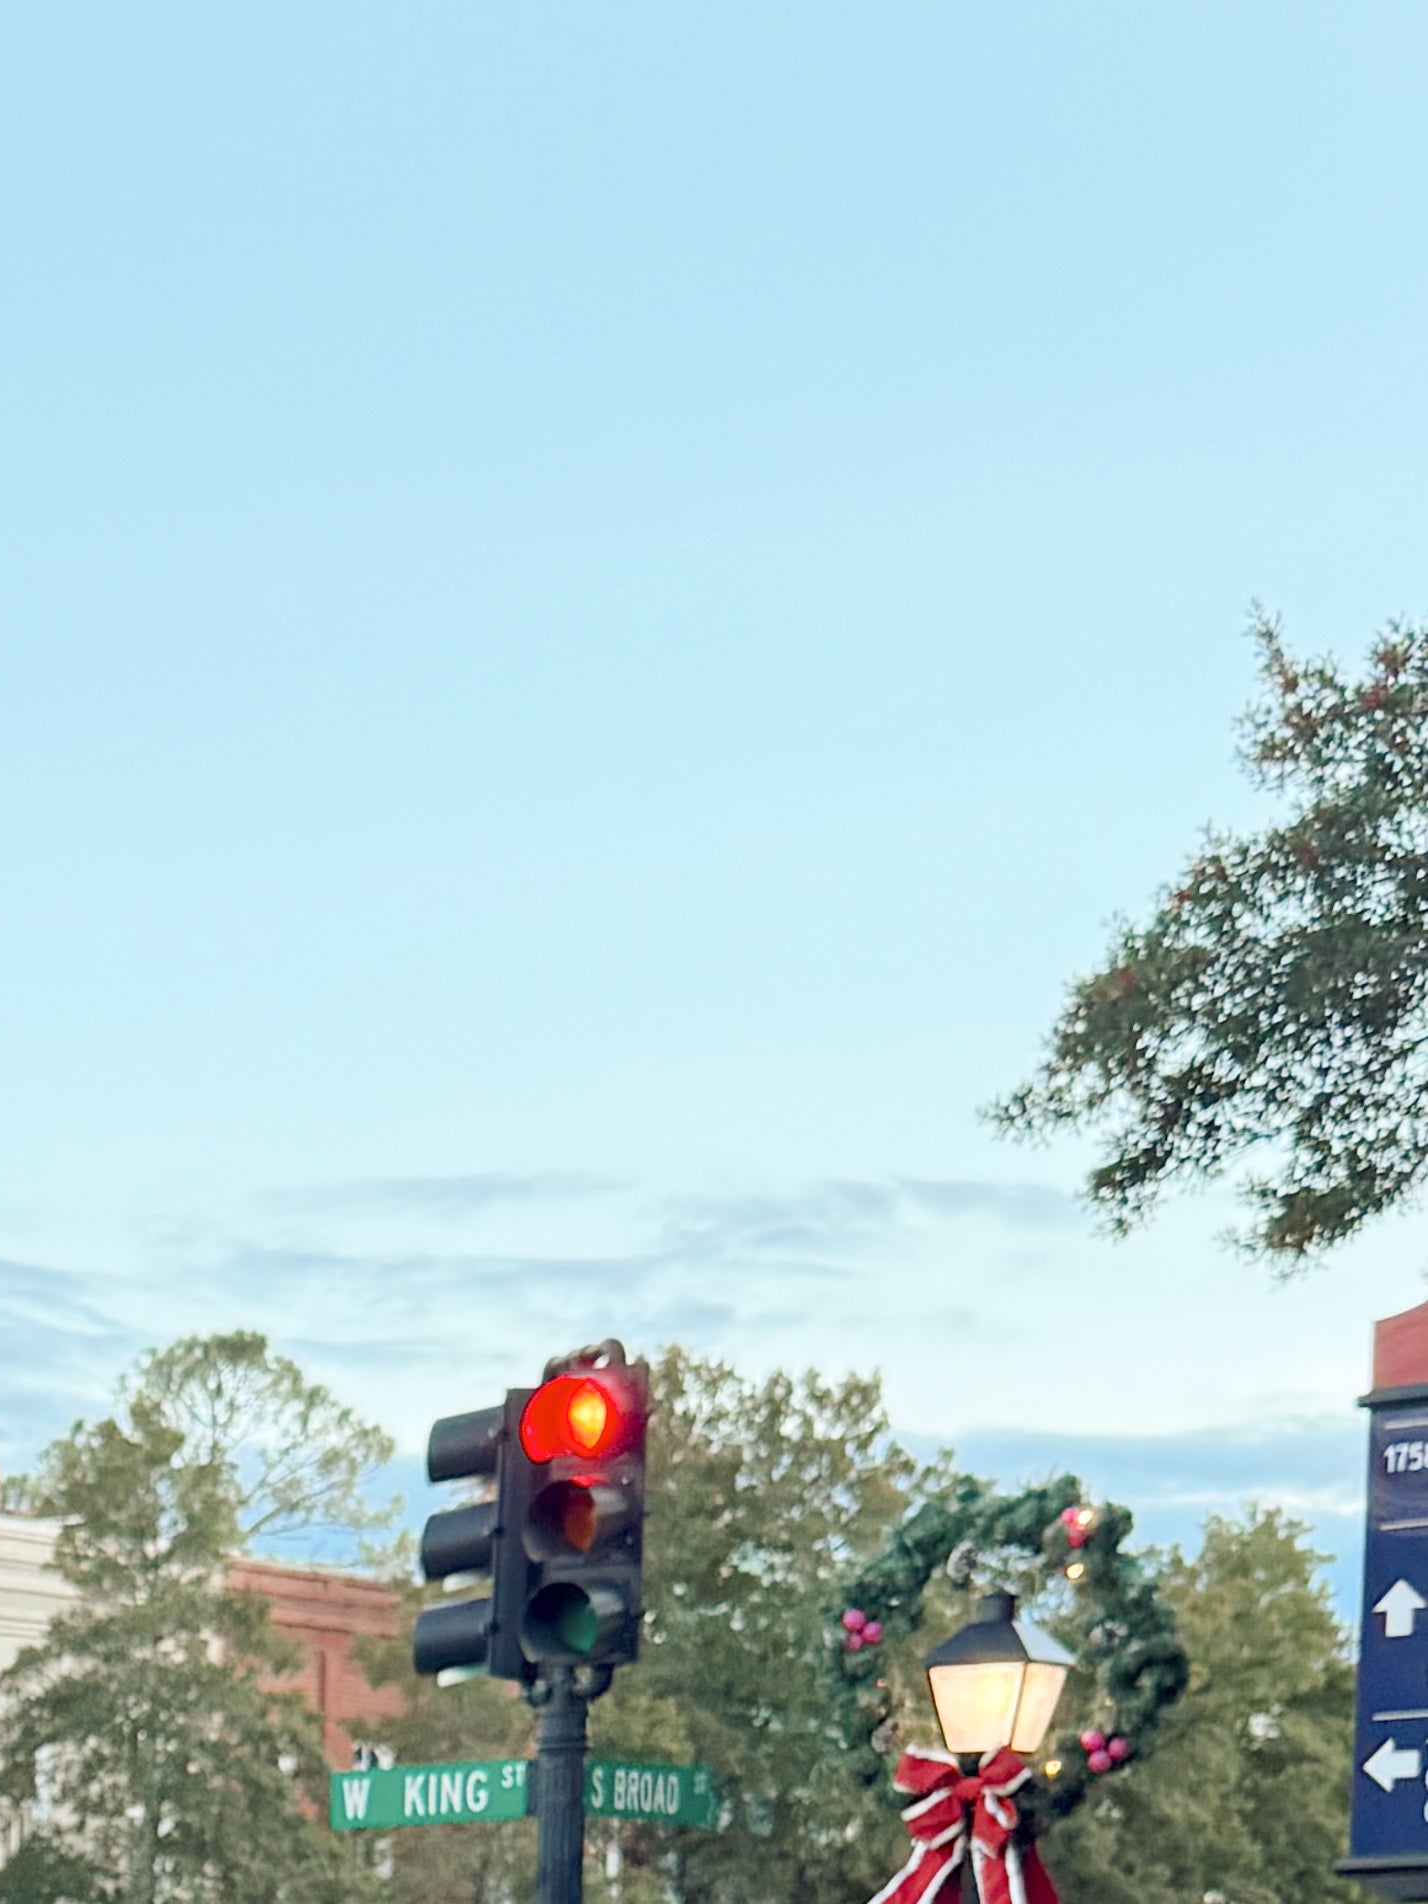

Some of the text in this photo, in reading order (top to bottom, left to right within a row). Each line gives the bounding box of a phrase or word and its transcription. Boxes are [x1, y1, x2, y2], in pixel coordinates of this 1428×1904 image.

[1384, 1441, 1428, 1473] 175
[342, 1763, 526, 1820] W KING ST
[591, 1766, 604, 1809] S
[614, 1767, 680, 1815] BROAD
